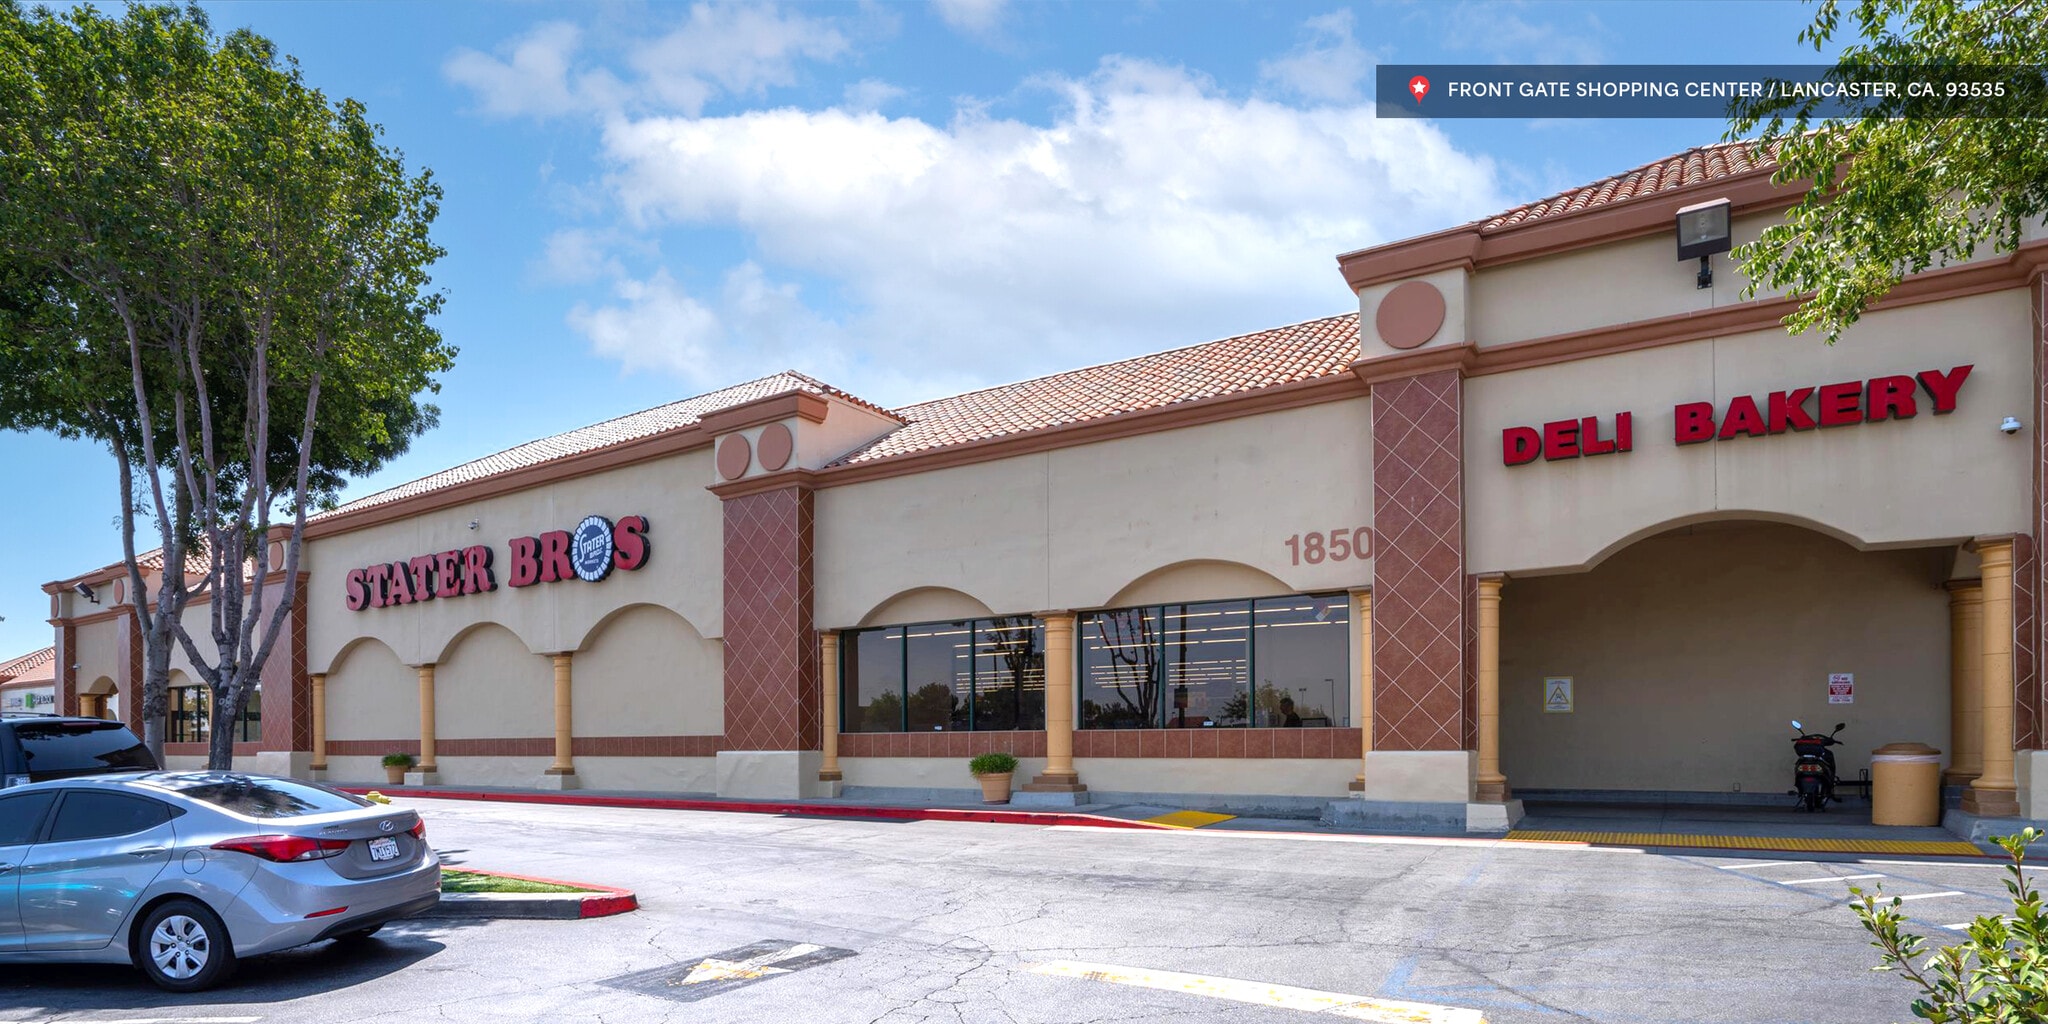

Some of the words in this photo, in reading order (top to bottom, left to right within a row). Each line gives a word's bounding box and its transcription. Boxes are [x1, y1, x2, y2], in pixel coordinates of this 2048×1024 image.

[1502, 411, 1633, 467] DELI
[1674, 364, 1975, 447] BAKERY
[580, 533, 605, 563] STATER
[1284, 526, 1374, 567] 1850
[346, 544, 498, 611] STATER
